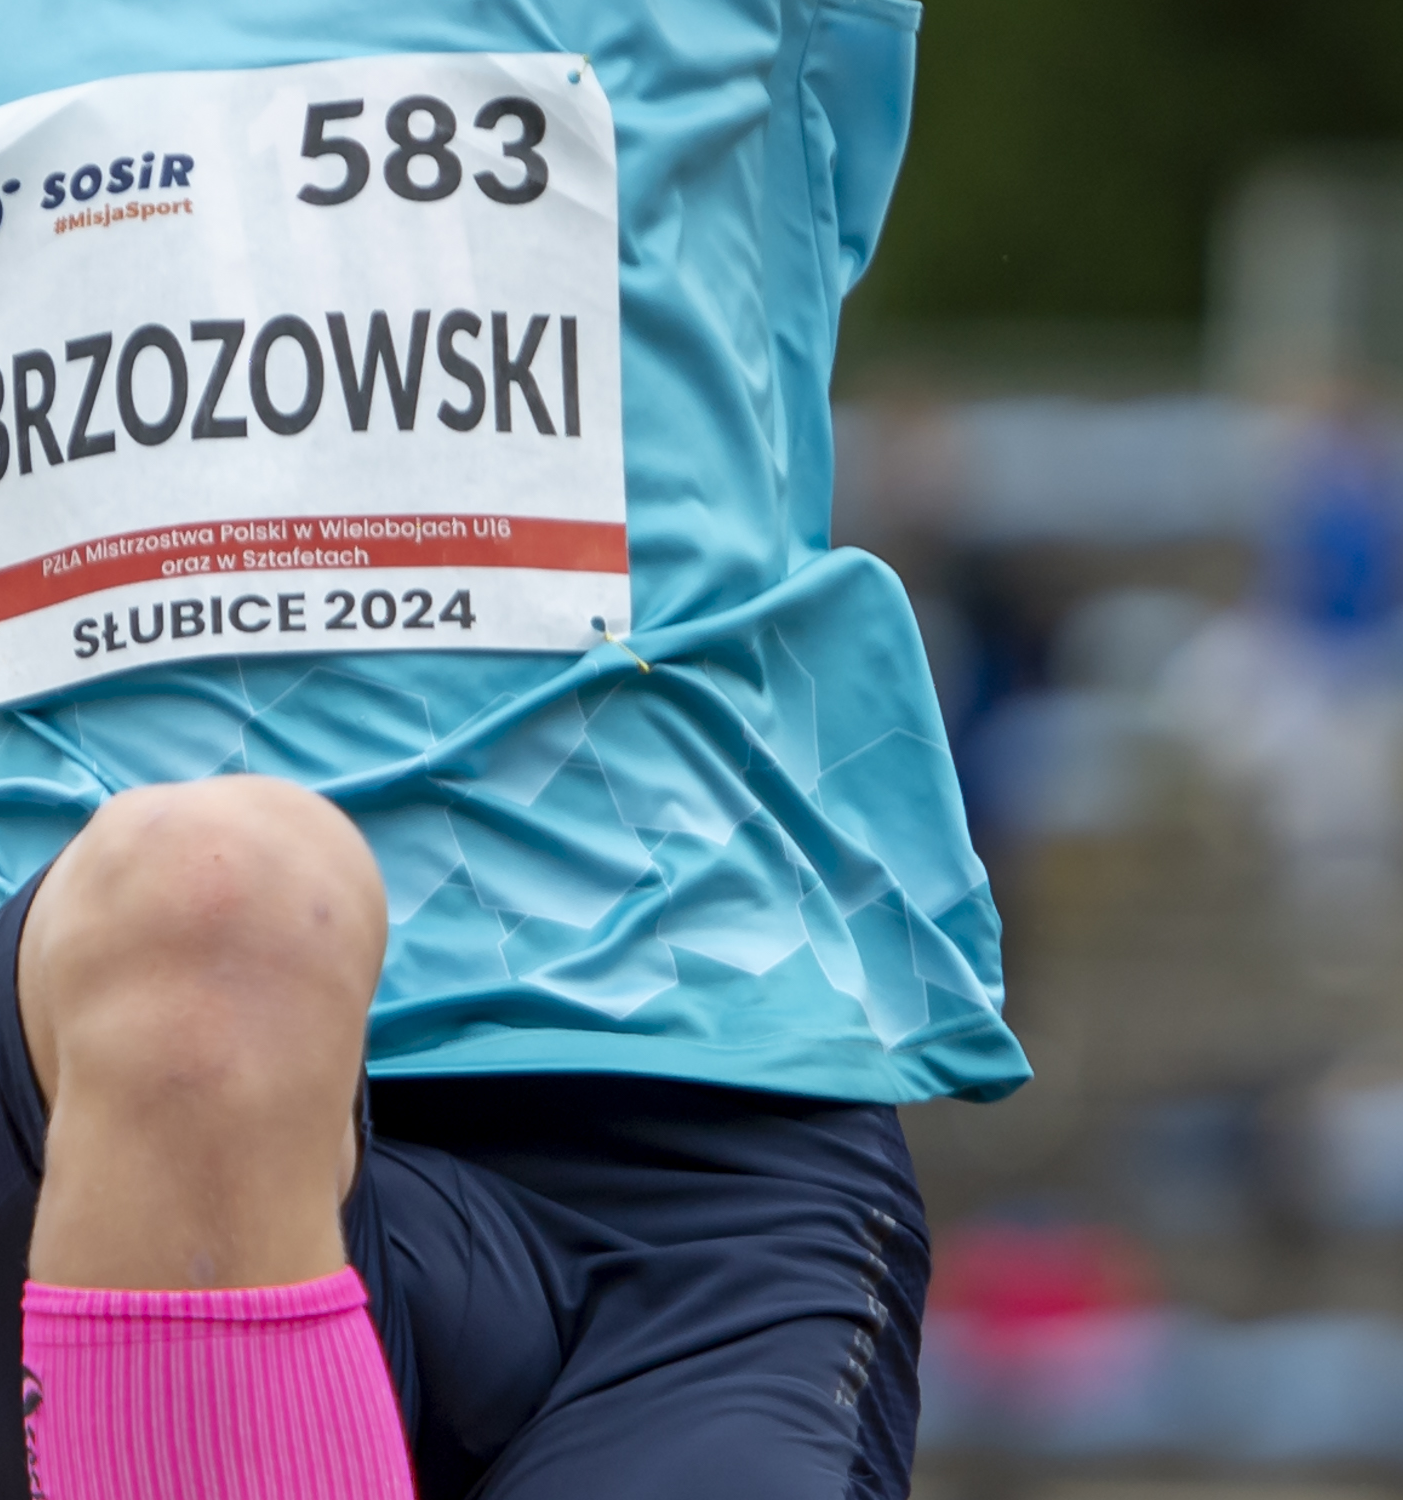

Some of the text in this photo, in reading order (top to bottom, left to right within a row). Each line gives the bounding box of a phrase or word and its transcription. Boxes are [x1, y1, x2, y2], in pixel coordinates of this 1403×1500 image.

[296, 93, 549, 207] 583
[53, 197, 194, 234] #MisjaSport
[41, 516, 512, 577] PZLA Mistrzostwa Polski w Wielobojach U16
[160, 546, 370, 576] oraz w Sztafetach
[71, 587, 477, 659] SŁUBICE 2024
